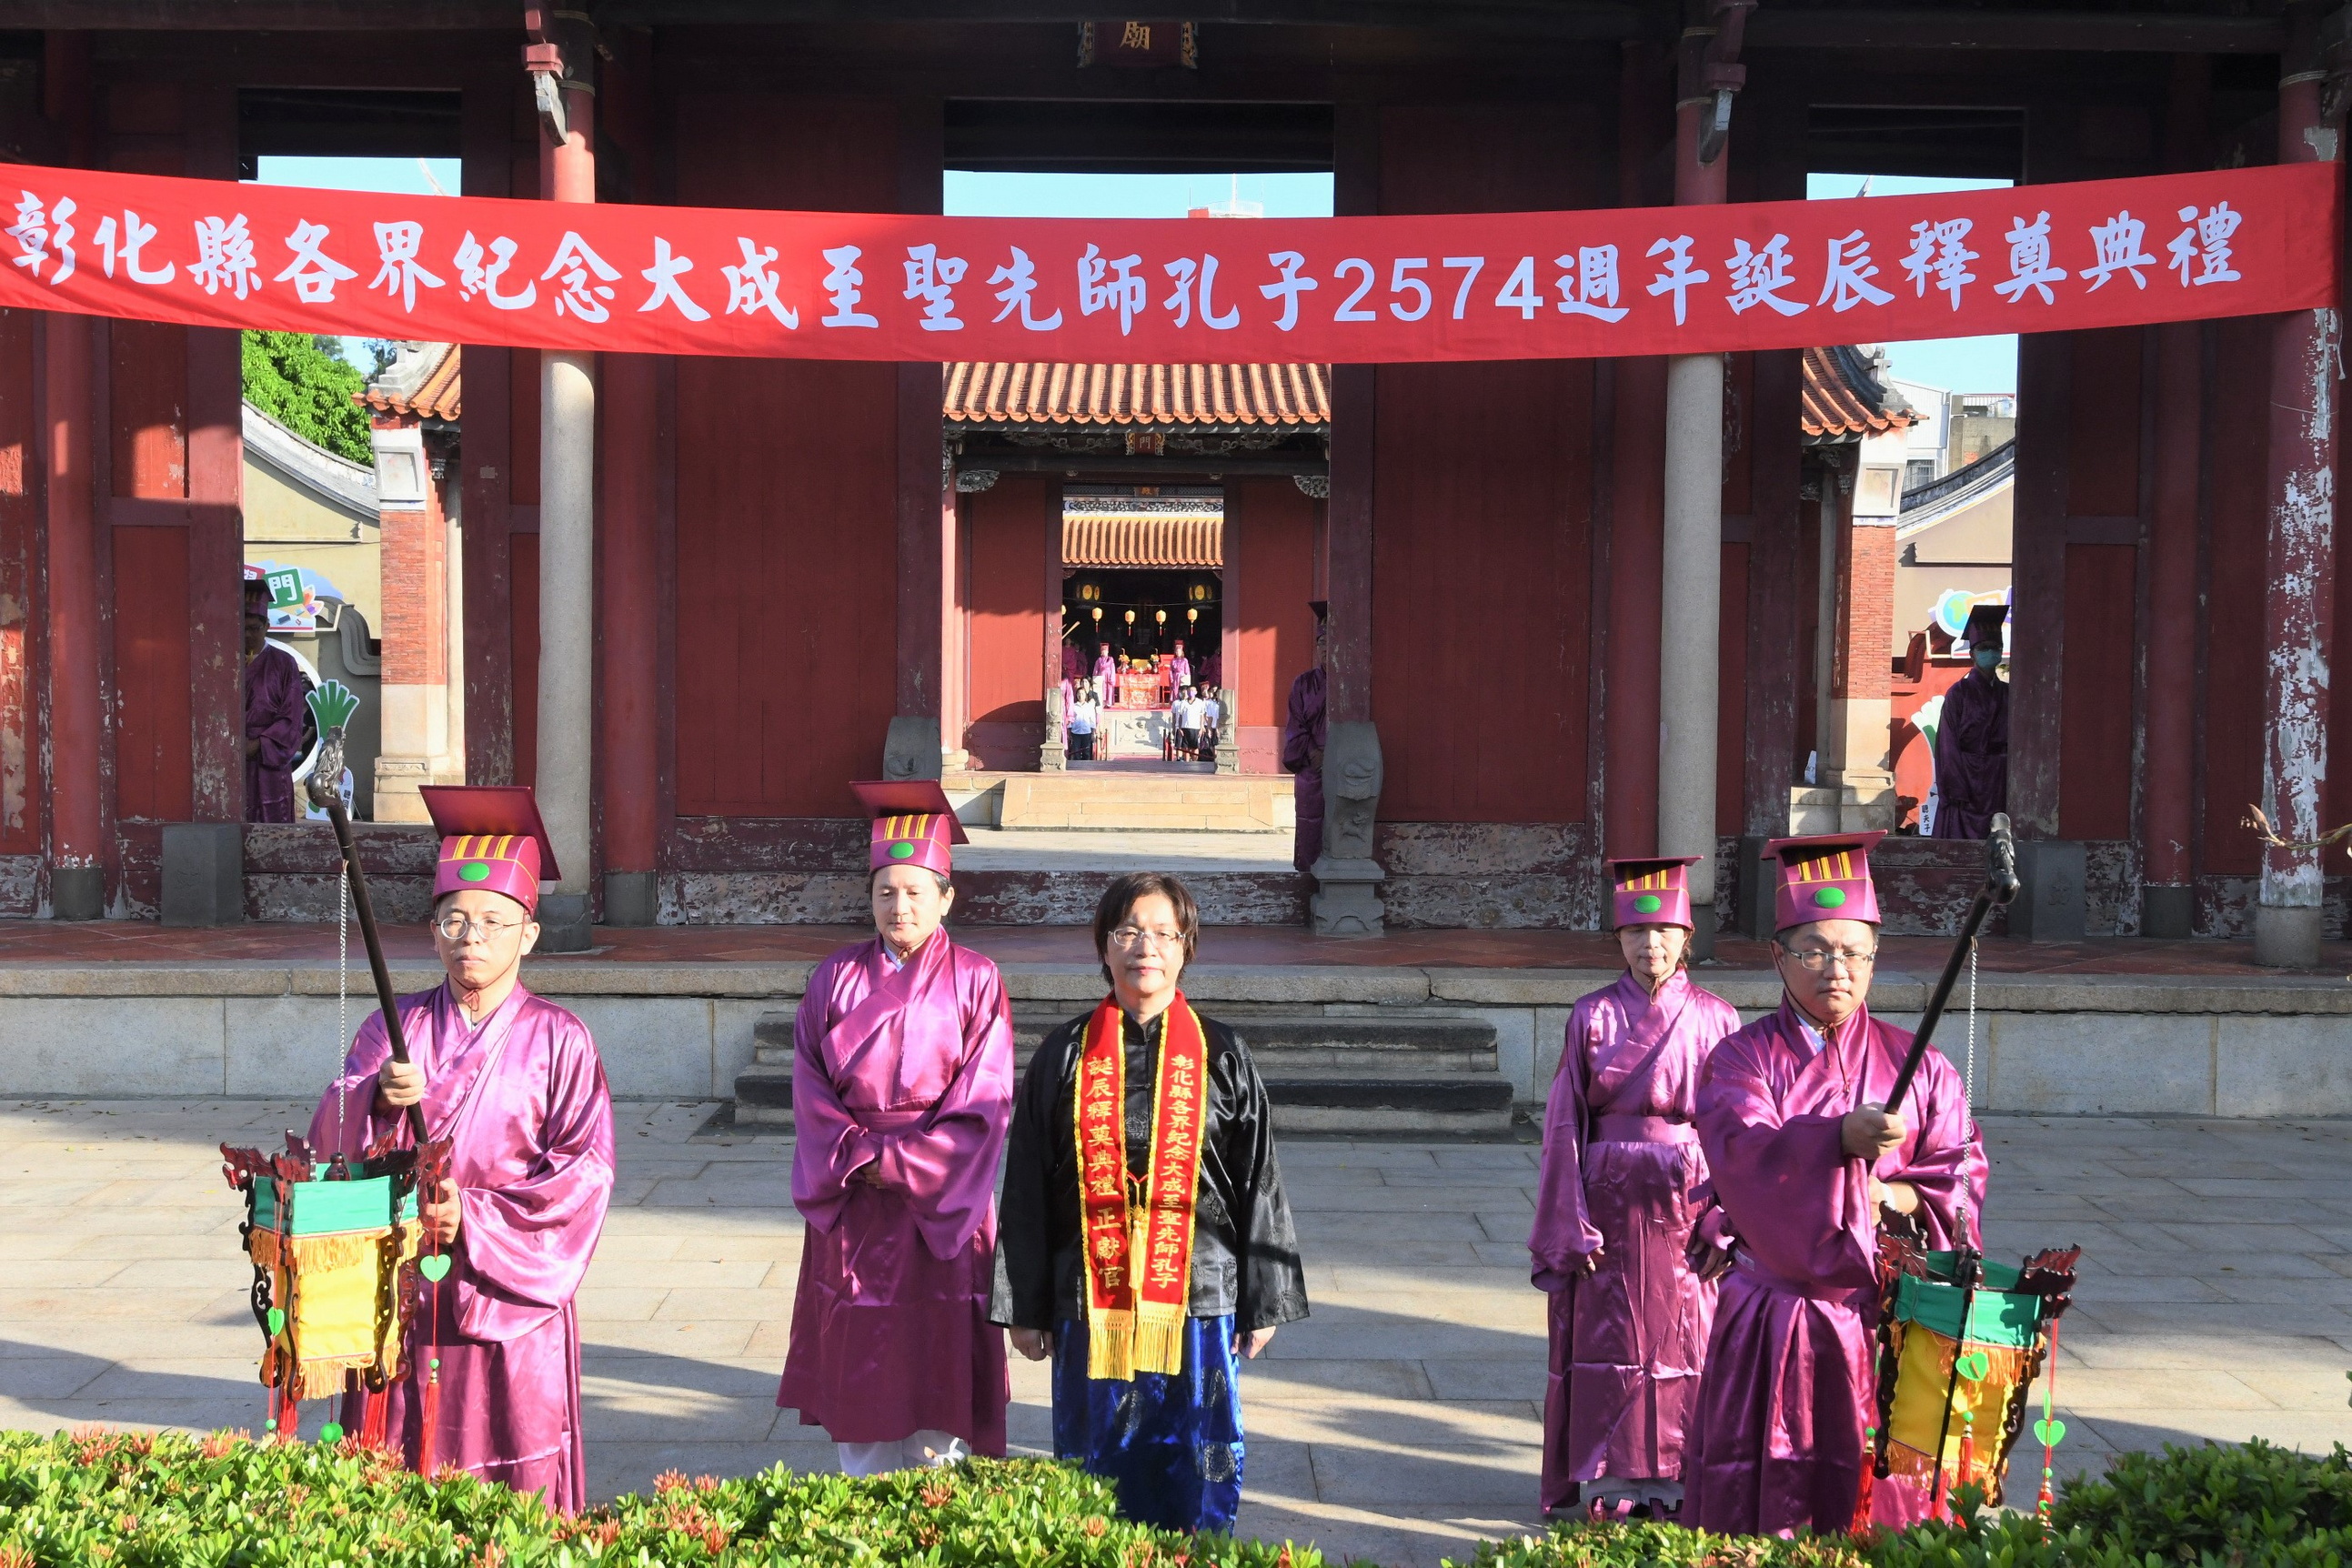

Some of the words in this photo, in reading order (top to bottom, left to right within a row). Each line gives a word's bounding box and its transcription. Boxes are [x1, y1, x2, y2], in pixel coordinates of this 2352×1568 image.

[1120, 21, 1151, 51] 廟
[5, 188, 2243, 337] 彰化縣各界紀念大成至聖先師孔子2574週年誕辰釋奠典禮
[1139, 436, 1151, 449] 門
[268, 574, 297, 605] 門
[1086, 1057, 1118, 1196] 誕辰釋奠典禮
[1151, 1054, 1195, 1290] 彰化縣各界紀念大成至聖先師孔子
[1091, 1208, 1124, 1289] 正獻官
